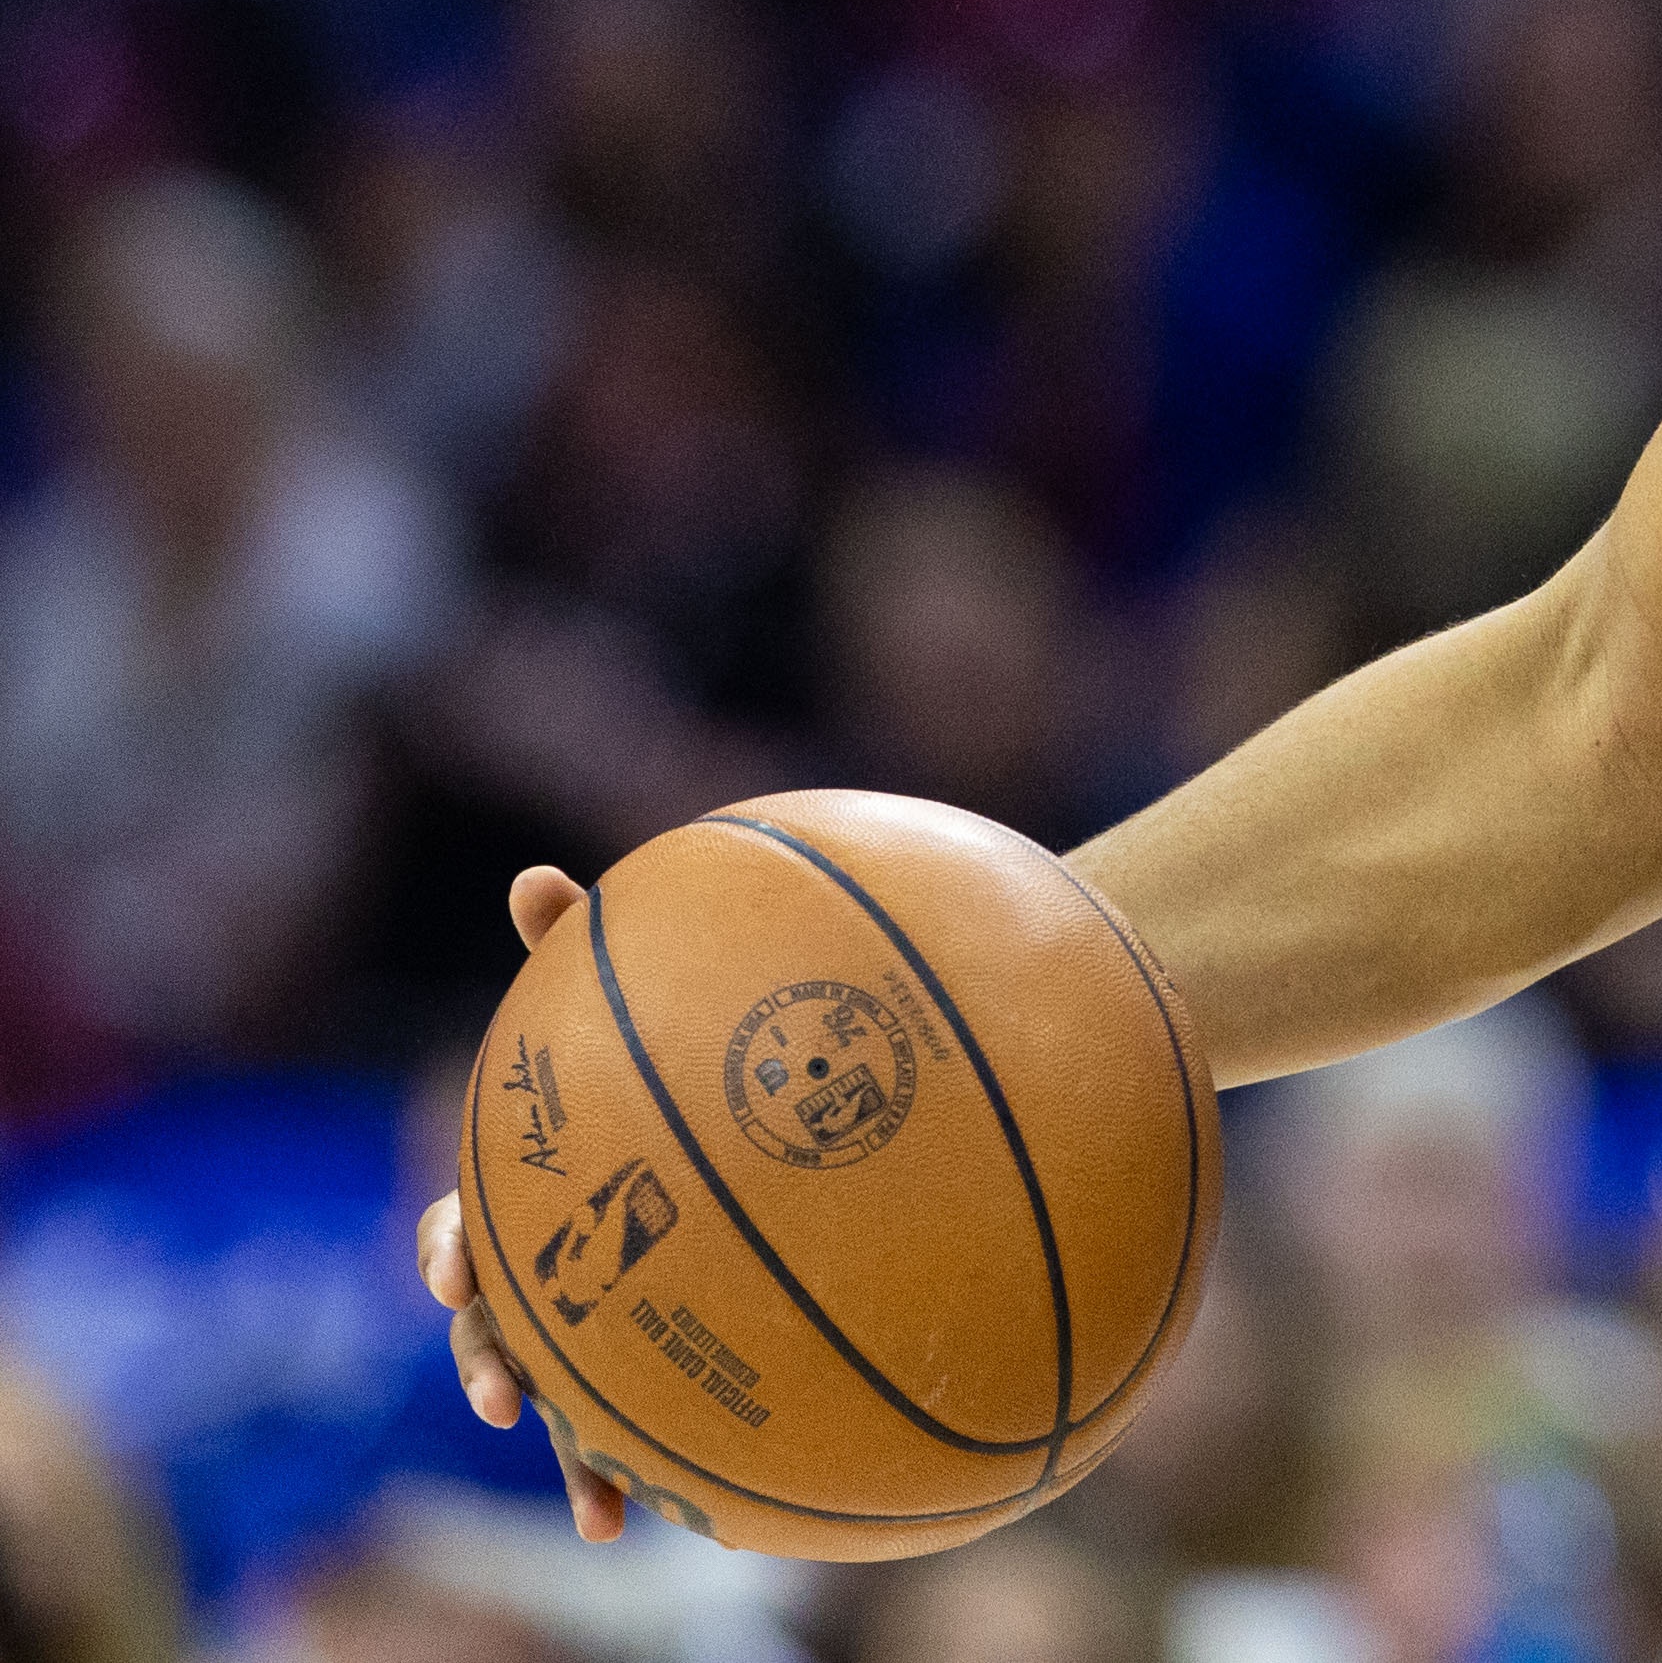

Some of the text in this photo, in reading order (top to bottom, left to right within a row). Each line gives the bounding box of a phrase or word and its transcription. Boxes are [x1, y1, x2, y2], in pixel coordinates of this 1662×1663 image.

[629, 1297, 772, 1429] OFFICIAL GAME BALL
